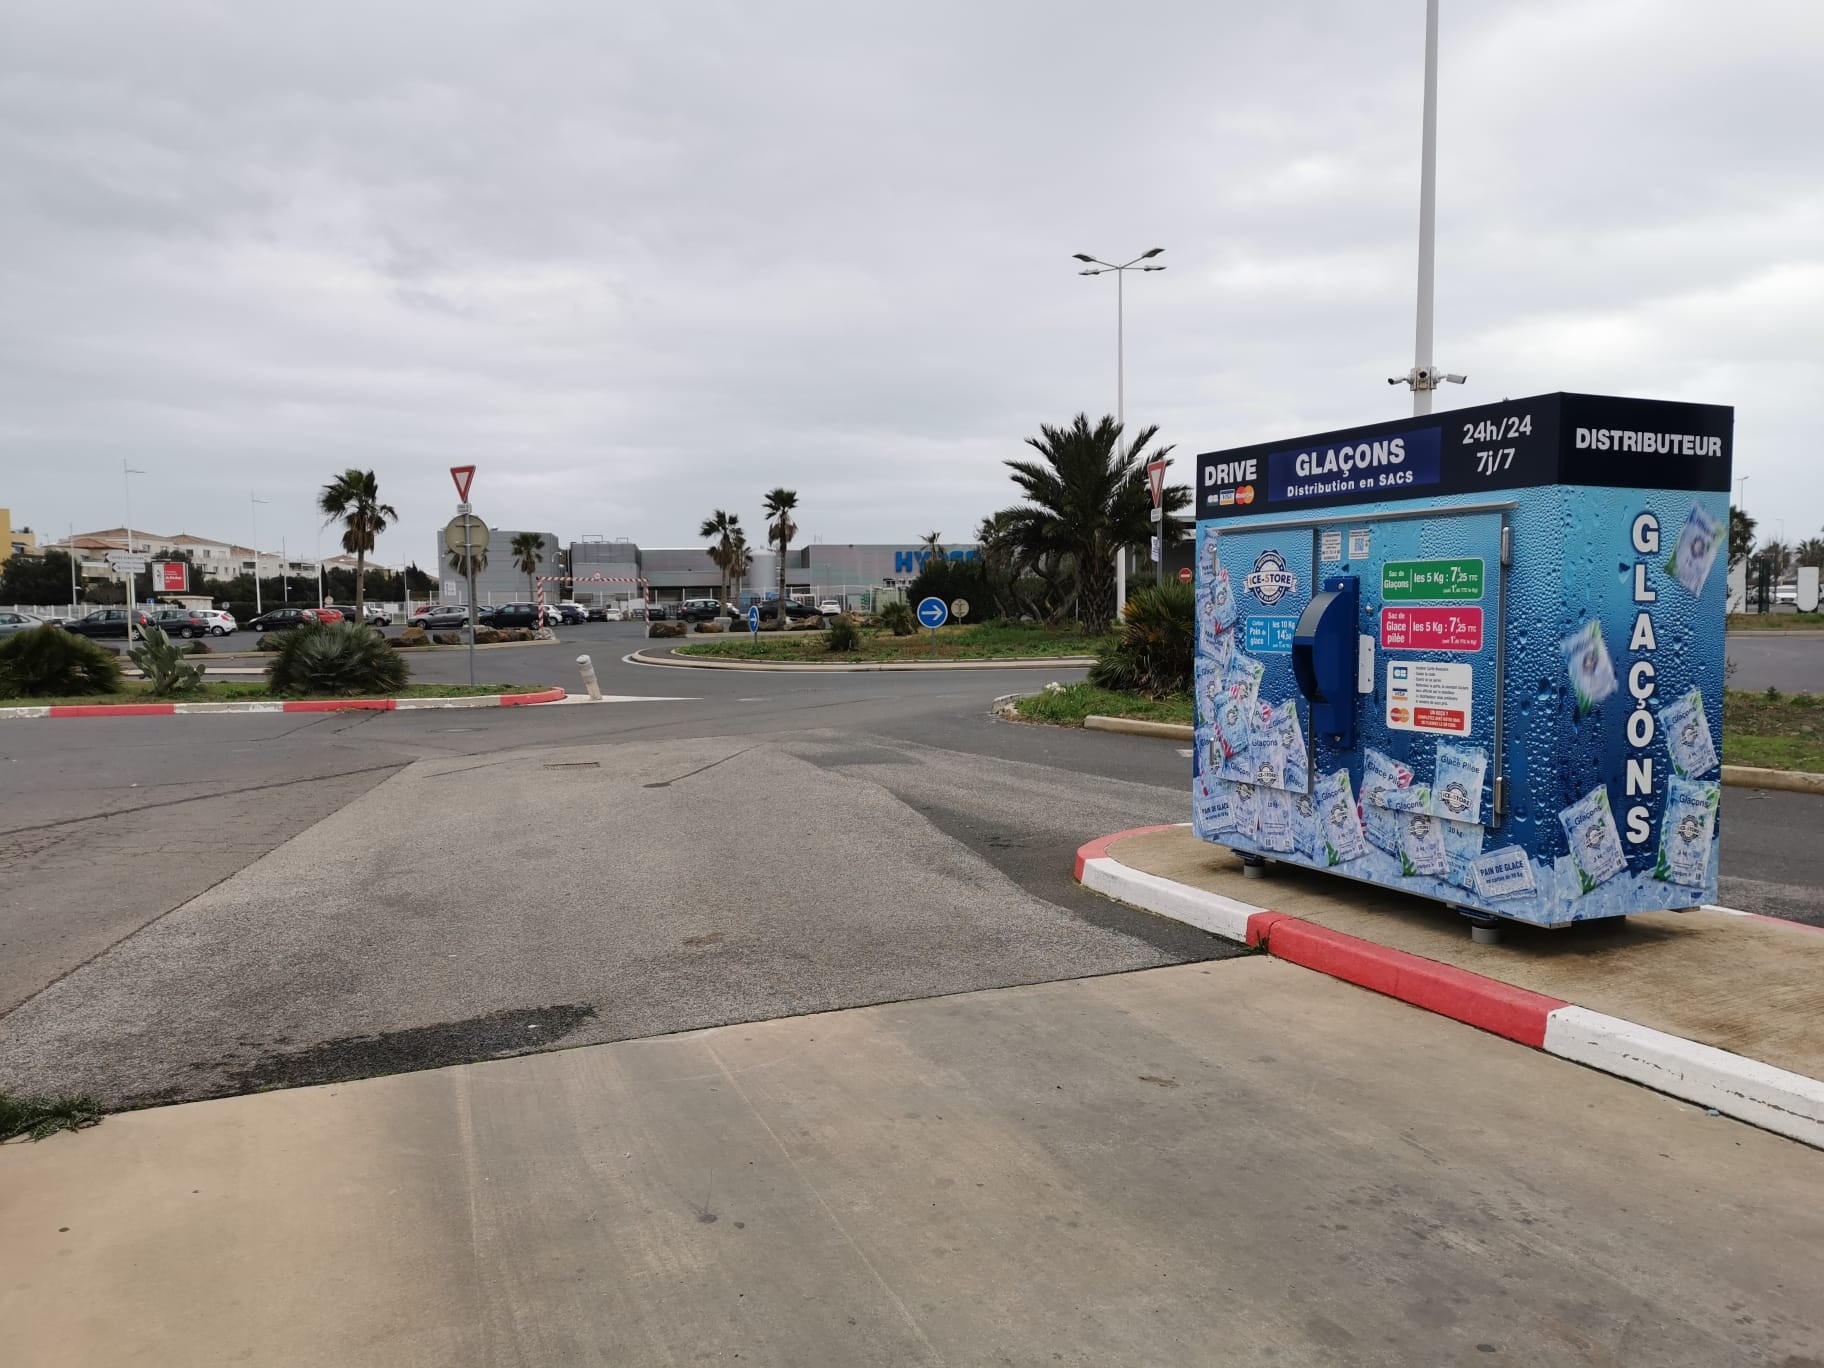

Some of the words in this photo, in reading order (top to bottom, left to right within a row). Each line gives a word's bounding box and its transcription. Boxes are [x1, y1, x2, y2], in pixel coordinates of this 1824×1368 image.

[1462, 415, 1532, 445] 24h/24
[1575, 428, 1722, 457] DISTRIBUTEUR
[1295, 438, 1406, 478] GLAÇONS
[1476, 448, 1516, 476] 7j/7
[1204, 458, 1257, 486] DRIVE
[1287, 479, 1355, 498] Distribution
[1359, 478, 1375, 489] en
[1379, 470, 1414, 486] SACS
[1384, 580, 1409, 590] Glaçons
[1414, 573, 1425, 582] les
[1426, 573, 1432, 582] 5
[1434, 572, 1444, 584] Kg
[1386, 621, 1406, 631] Glace
[1413, 622, 1424, 632] les
[1426, 622, 1431, 632] 5
[1432, 622, 1443, 634] Kg
[1626, 513, 1660, 845] GLAÇONS
[1440, 756, 1460, 767] Glace
[1680, 794, 1710, 808] Glaçons
[1575, 805, 1602, 826] Glaçons
[1480, 866, 1494, 877] PAIN
[1494, 864, 1504, 874] DE
[1504, 860, 1524, 872] GLACE
